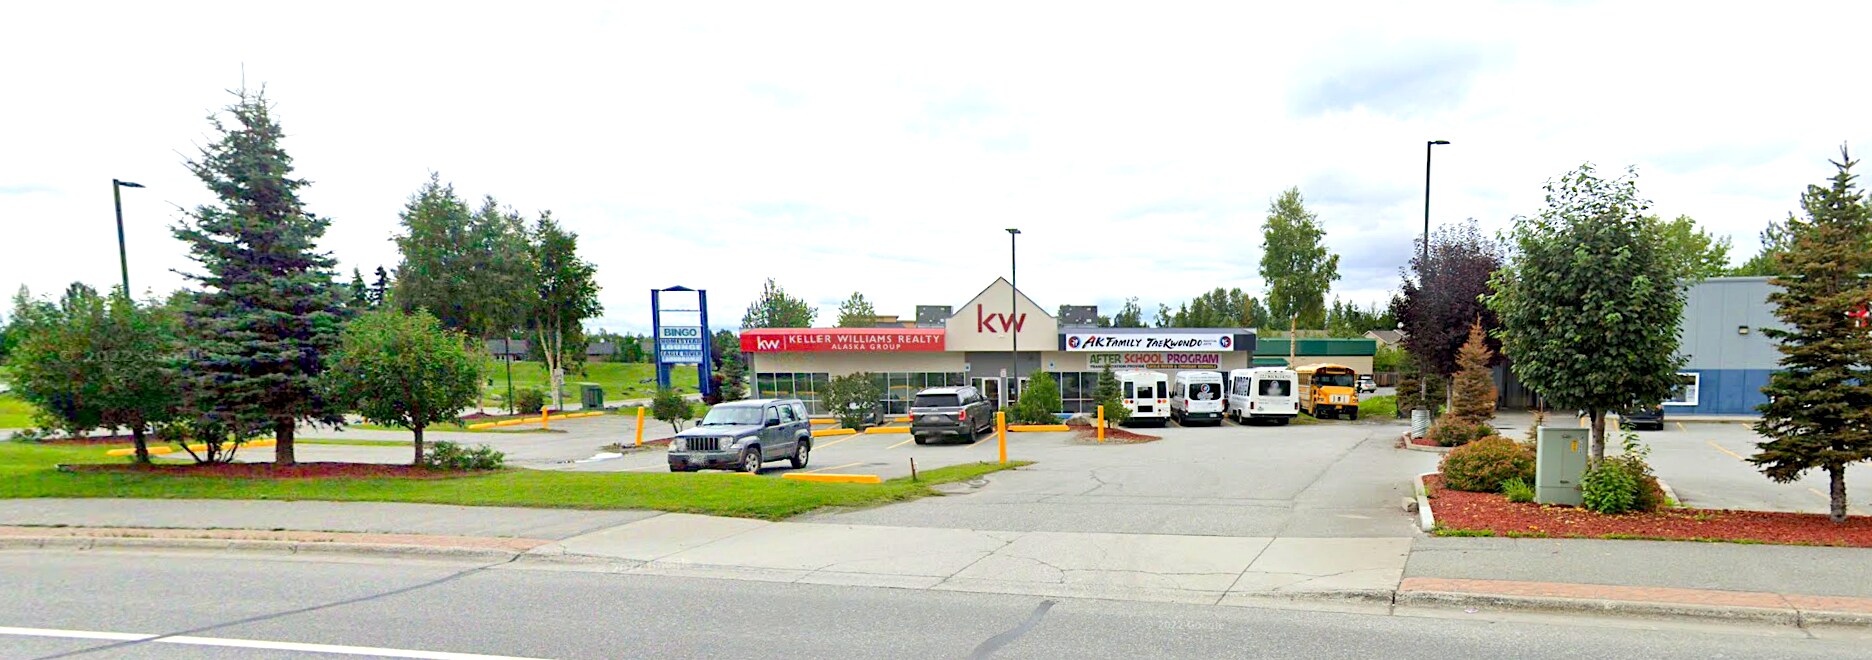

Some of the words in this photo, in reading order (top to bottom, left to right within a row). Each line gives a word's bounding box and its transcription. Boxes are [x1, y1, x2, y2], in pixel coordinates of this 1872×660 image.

[977, 303, 1027, 333] kw
[664, 328, 697, 337] BINGO
[757, 335, 780, 350] kw
[789, 334, 831, 344] KELLER
[836, 334, 892, 344] WILLIAMS
[898, 334, 940, 344] REALTY
[1105, 336, 1143, 348] FAMILY
[1089, 353, 1122, 364] AFTER
[1124, 352, 1164, 364] SCHOOL
[1167, 353, 1219, 364] PROGRAM
